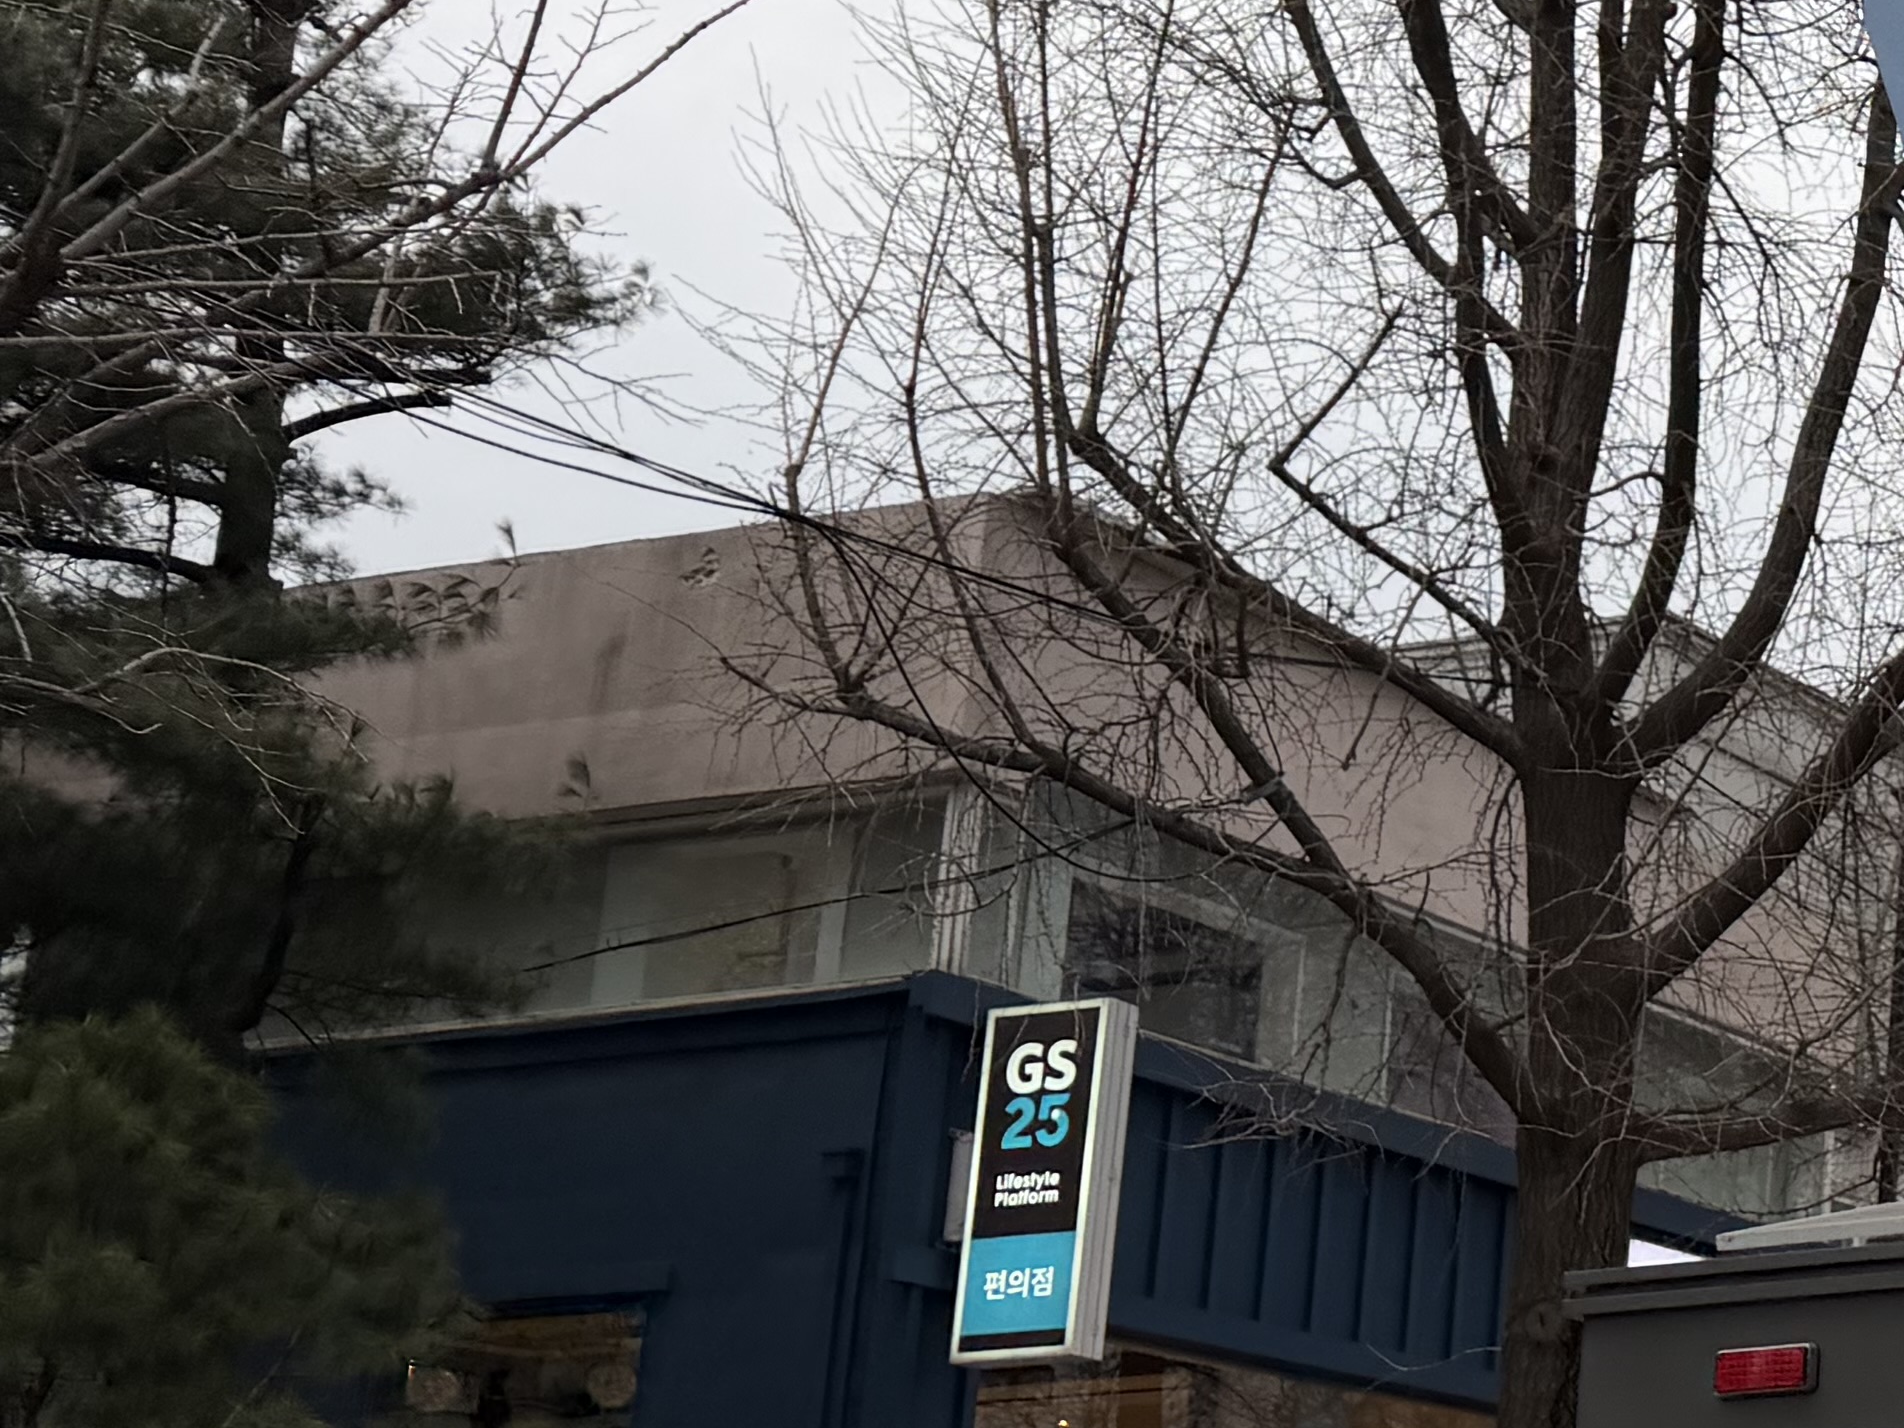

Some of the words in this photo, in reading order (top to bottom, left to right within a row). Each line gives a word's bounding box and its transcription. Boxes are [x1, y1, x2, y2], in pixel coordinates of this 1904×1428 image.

[1005, 1038, 1078, 1095] GS
[1000, 1092, 1071, 1150] 25
[993, 1187, 1060, 1208] Platform
[995, 1170, 1060, 1192] Lifestyle
[983, 1265, 1055, 1301] 편의점
